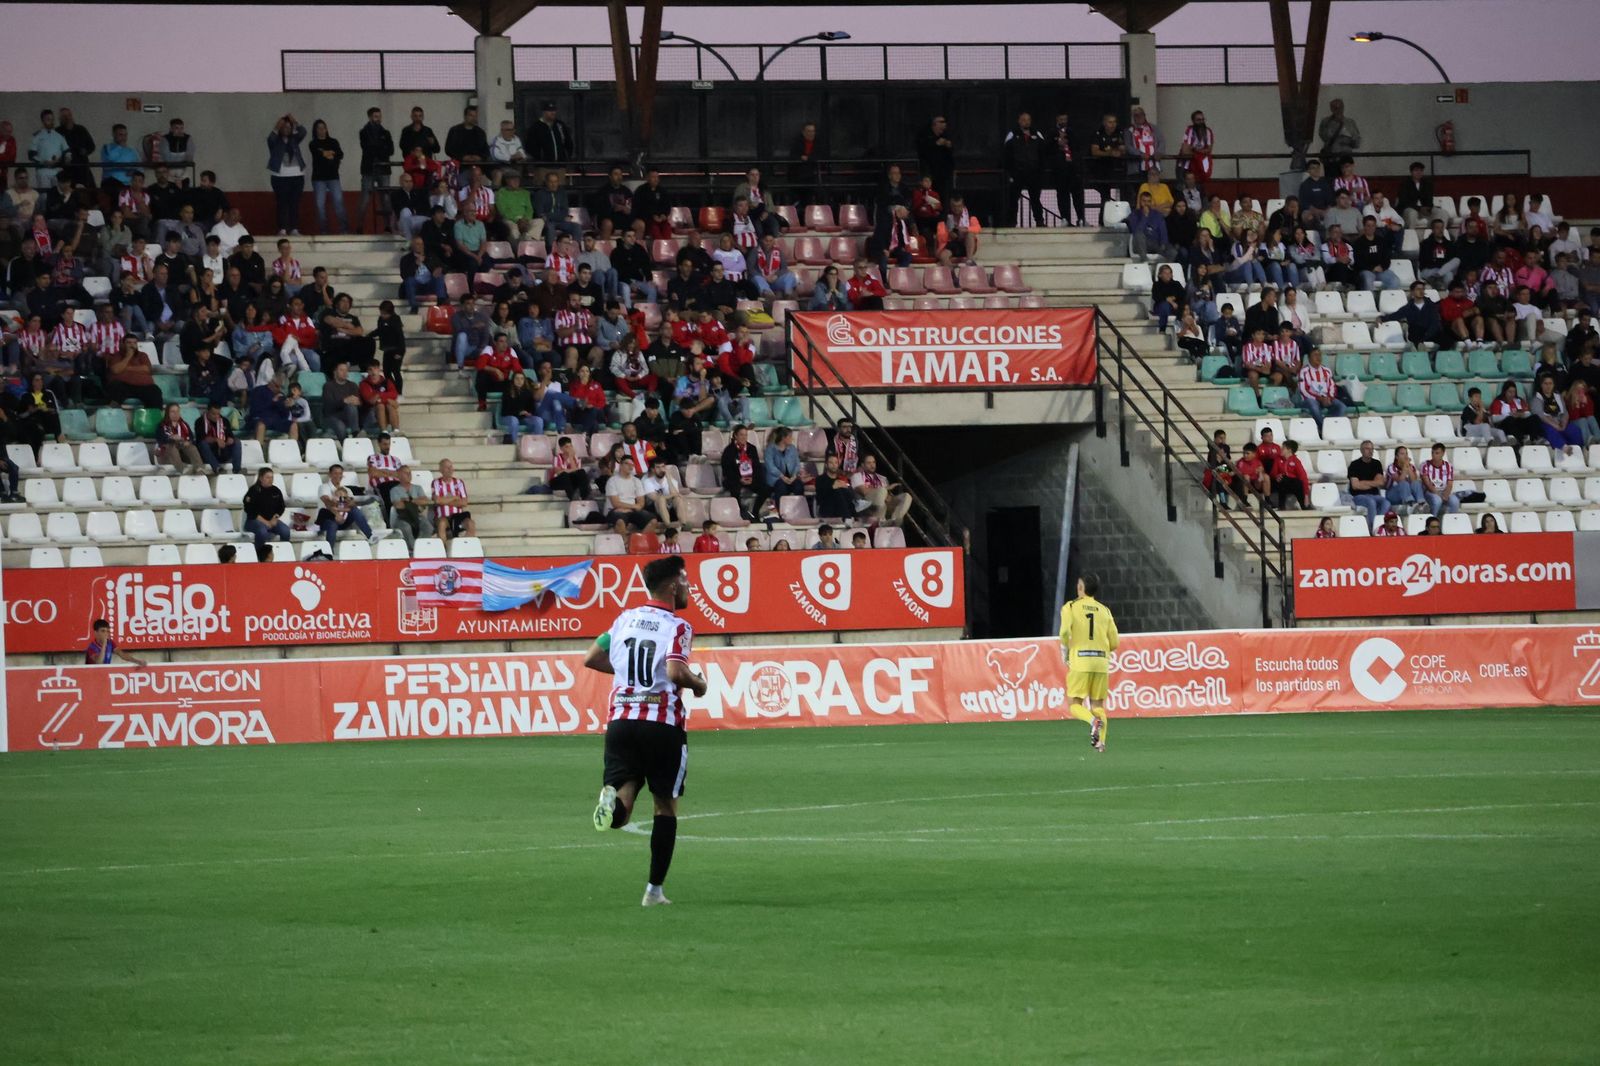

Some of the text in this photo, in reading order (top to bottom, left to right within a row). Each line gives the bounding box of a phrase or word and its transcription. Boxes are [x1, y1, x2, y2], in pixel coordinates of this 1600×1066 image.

[881, 350, 1062, 384] TAMAR, S.A.
[717, 564, 740, 602] 8
[818, 562, 841, 600] 8
[921, 559, 943, 597] 8
[1299, 558, 1572, 589] zamora24horas.com
[116, 572, 215, 617] fisio
[688, 583, 726, 628] ZAMORA
[789, 581, 827, 626] ZAMORA
[892, 578, 930, 624] ZAMORA
[117, 605, 231, 641] readapt
[118, 634, 198, 644] POLICLÍNICA
[244, 608, 372, 641] podoactiva
[262, 628, 371, 641] PODOLOGÍA Y BIOMECÁNICA
[456, 617, 582, 634] AYUNTAMIENTO
[1085, 613, 1094, 641] 1
[624, 637, 657, 688] 10
[1107, 641, 1230, 673] scuela
[1255, 656, 1339, 672] Escucha todos
[1410, 655, 1447, 669] COPE
[1479, 663, 1529, 678] COPE.es
[862, 656, 935, 715] CF
[1256, 677, 1341, 695] los partidos en
[1411, 670, 1473, 685] ZAMORA
[97, 709, 277, 749] ZAMORA
[333, 694, 581, 740] ZAMORANAS
